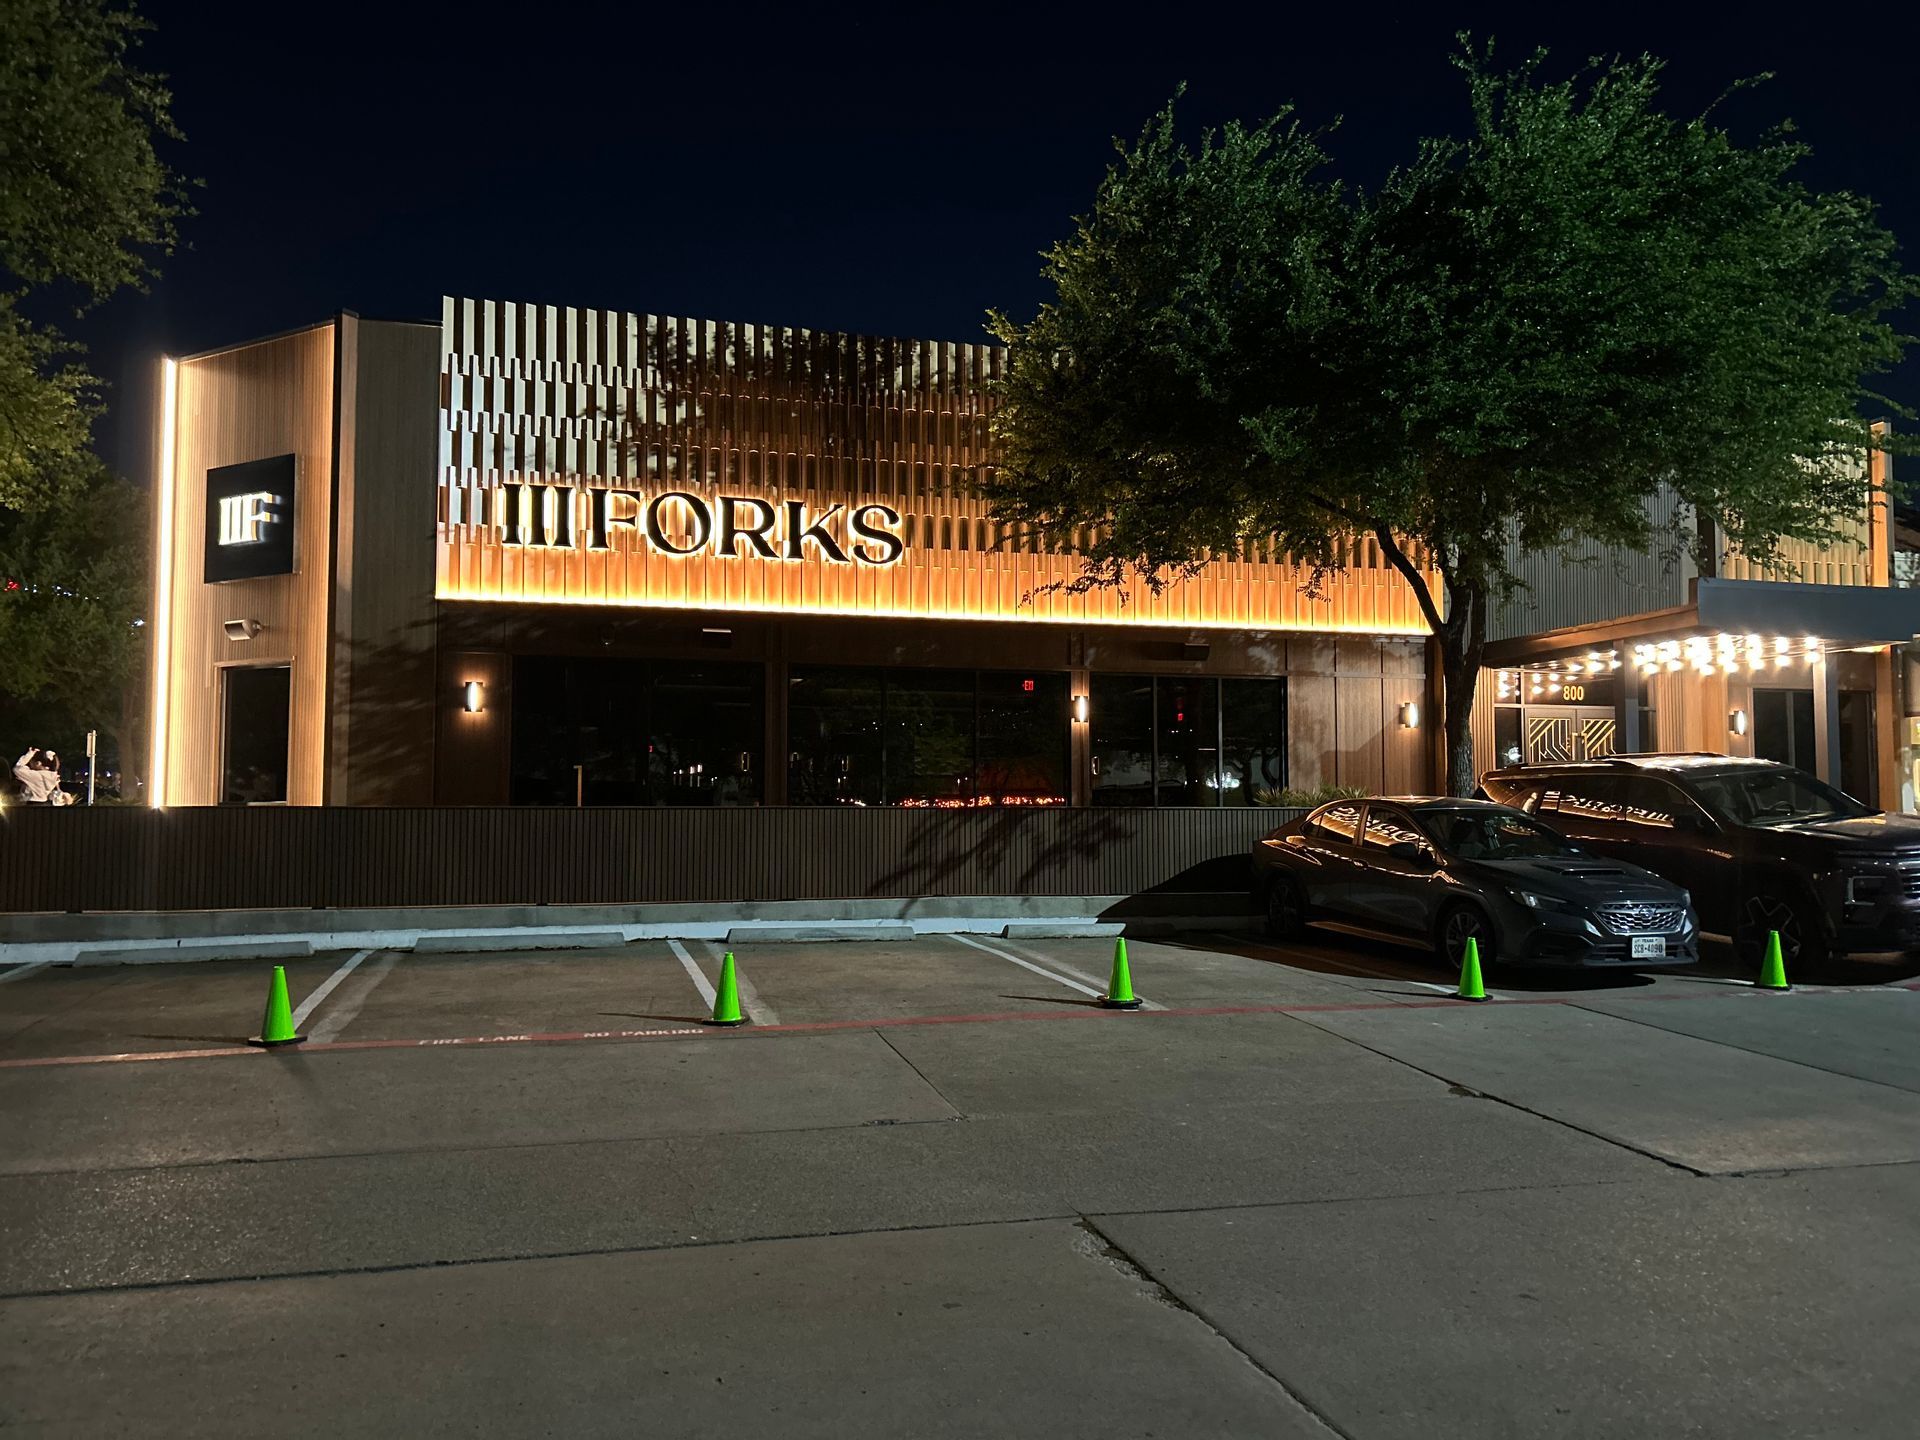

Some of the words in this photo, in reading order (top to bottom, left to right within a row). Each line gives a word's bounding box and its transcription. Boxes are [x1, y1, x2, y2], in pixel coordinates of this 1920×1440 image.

[1563, 685, 1584, 701] 800
[479, 1035, 532, 1043] LANE
[621, 1028, 704, 1037] PARKING
